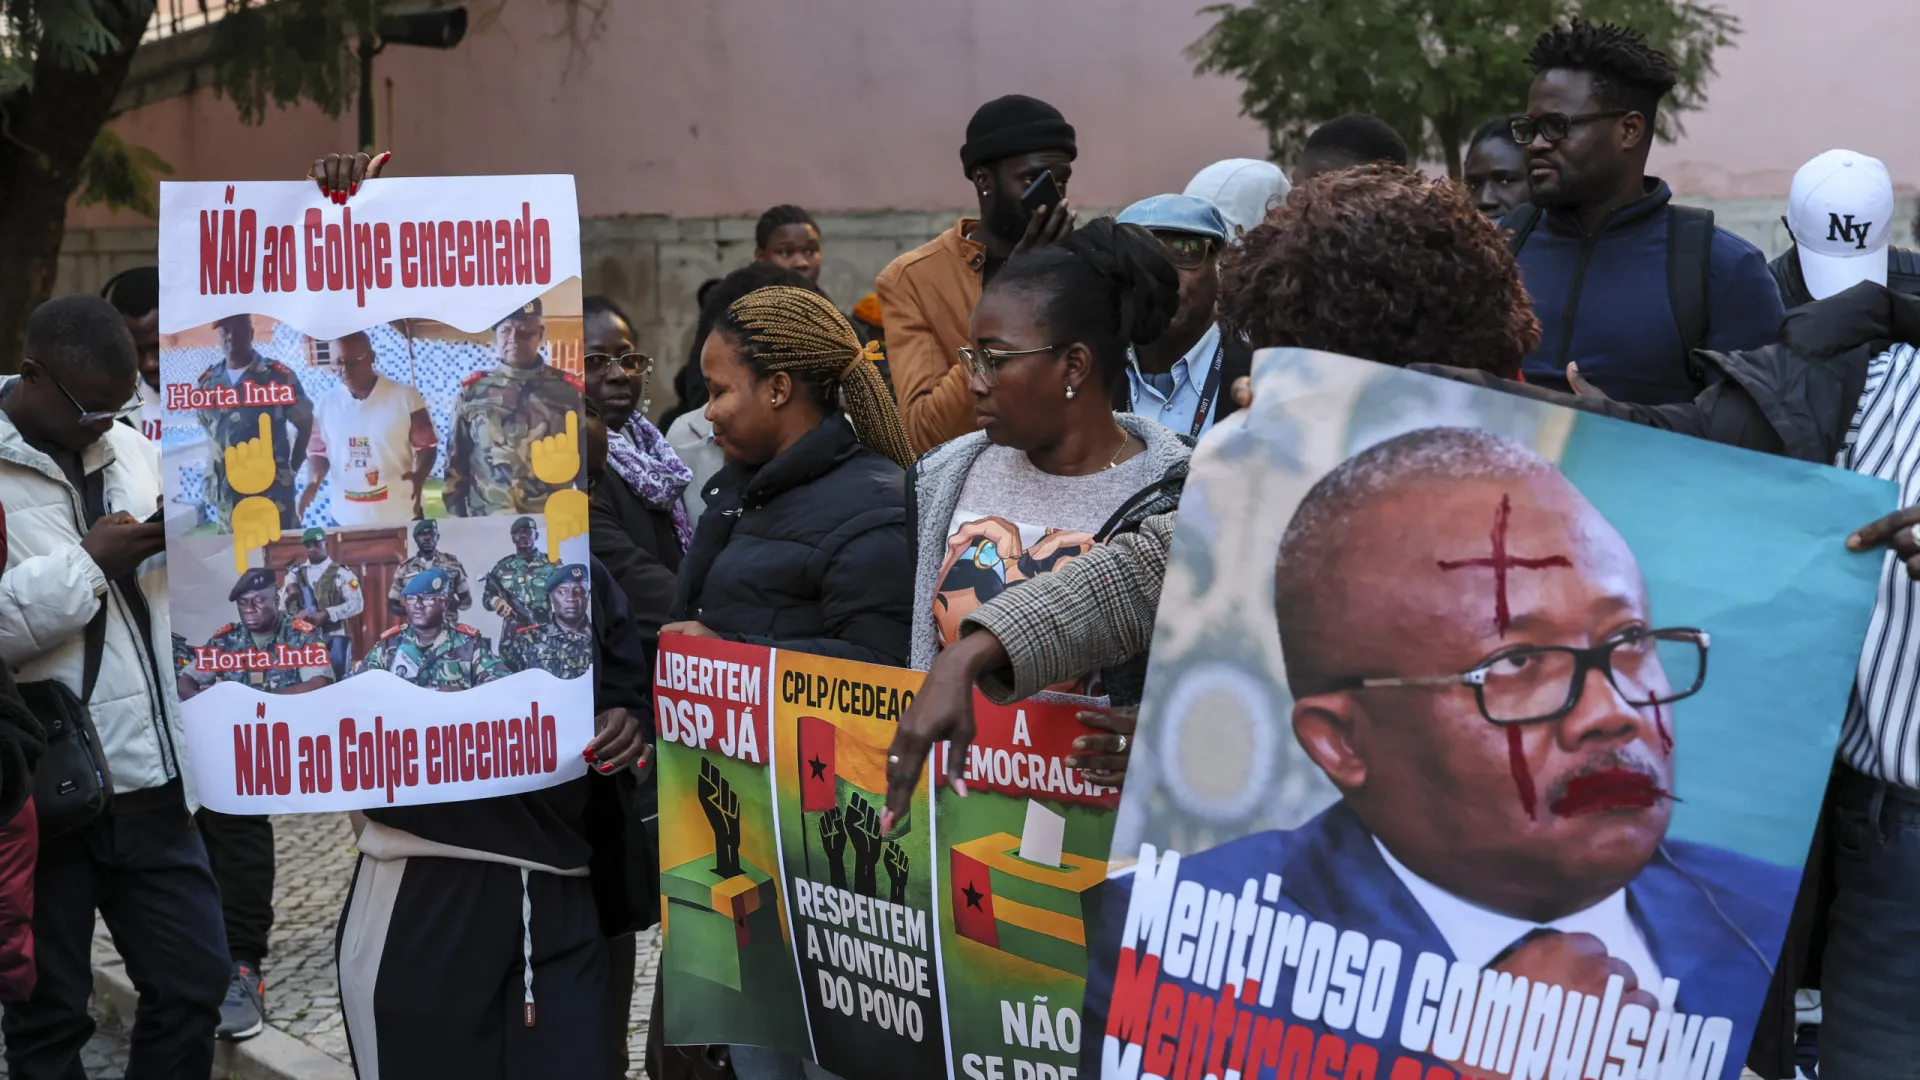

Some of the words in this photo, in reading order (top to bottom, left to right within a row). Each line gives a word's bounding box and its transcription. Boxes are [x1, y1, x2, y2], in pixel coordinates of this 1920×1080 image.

[200, 186, 257, 295] NÃO
[263, 225, 297, 293] ao
[304, 206, 392, 307] Golpe
[400, 202, 552, 288] encenado
[1826, 212, 1872, 250] NY
[167, 384, 239, 409] Horta
[244, 380, 296, 404] Inta
[196, 645, 272, 671] Horta
[277, 642, 330, 667] Inta
[656, 649, 761, 706] LIBERTEM
[234, 702, 291, 795] NÃO
[299, 735, 332, 794] ao
[339, 716, 418, 803] Golpe
[426, 702, 557, 785] encenado
[657, 695, 714, 750] DSP
[718, 706, 761, 763] JÁ
[1012, 709, 1032, 747] A
[794, 877, 928, 952] RESPEITEM
[807, 923, 824, 963] A
[823, 928, 931, 998] VONTADE
[1121, 842, 1402, 1040] Mentiroso
[1399, 950, 1733, 1080] compulsivo
[817, 968, 854, 1016] DO
[857, 981, 924, 1043] POVO
[1000, 995, 1082, 1054] NÃO
